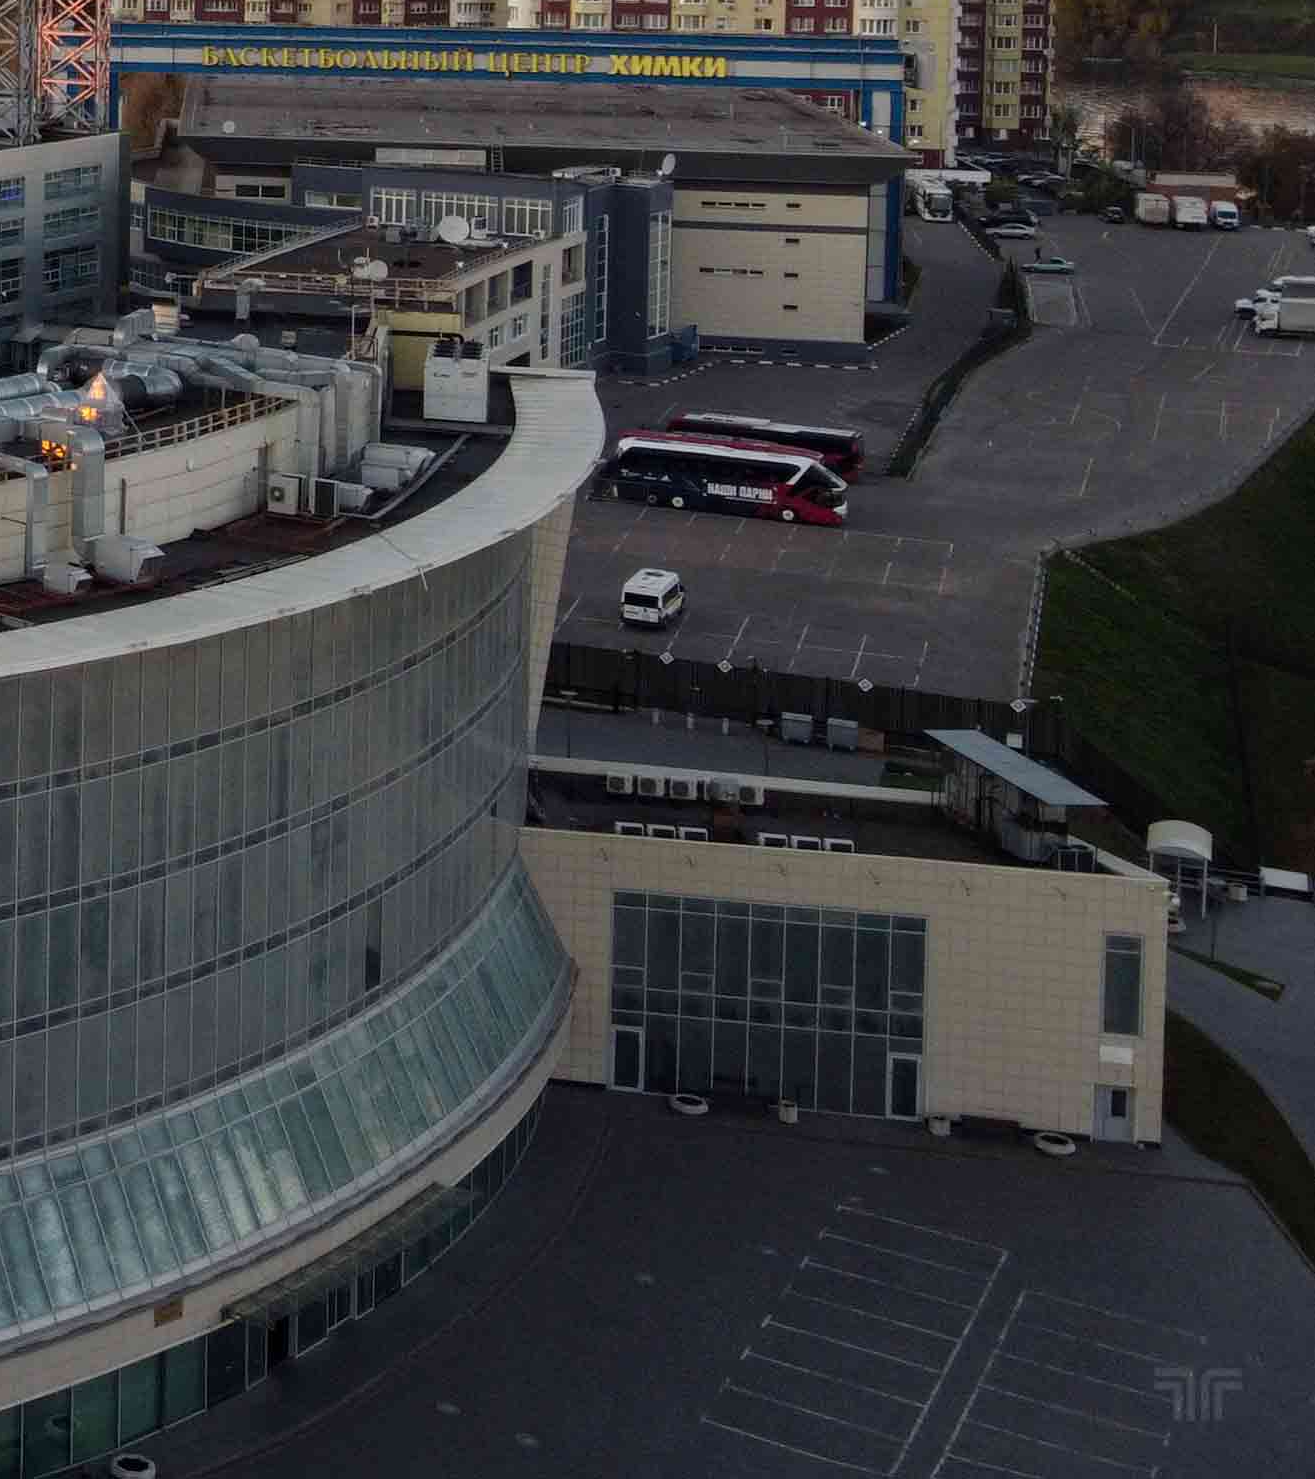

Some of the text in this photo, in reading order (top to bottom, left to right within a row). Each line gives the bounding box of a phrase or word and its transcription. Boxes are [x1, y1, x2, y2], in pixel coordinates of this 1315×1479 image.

[201, 45, 727, 78] БАСКЕТБОЛЬНЫЙ ЦЕНТР ХИМКИ
